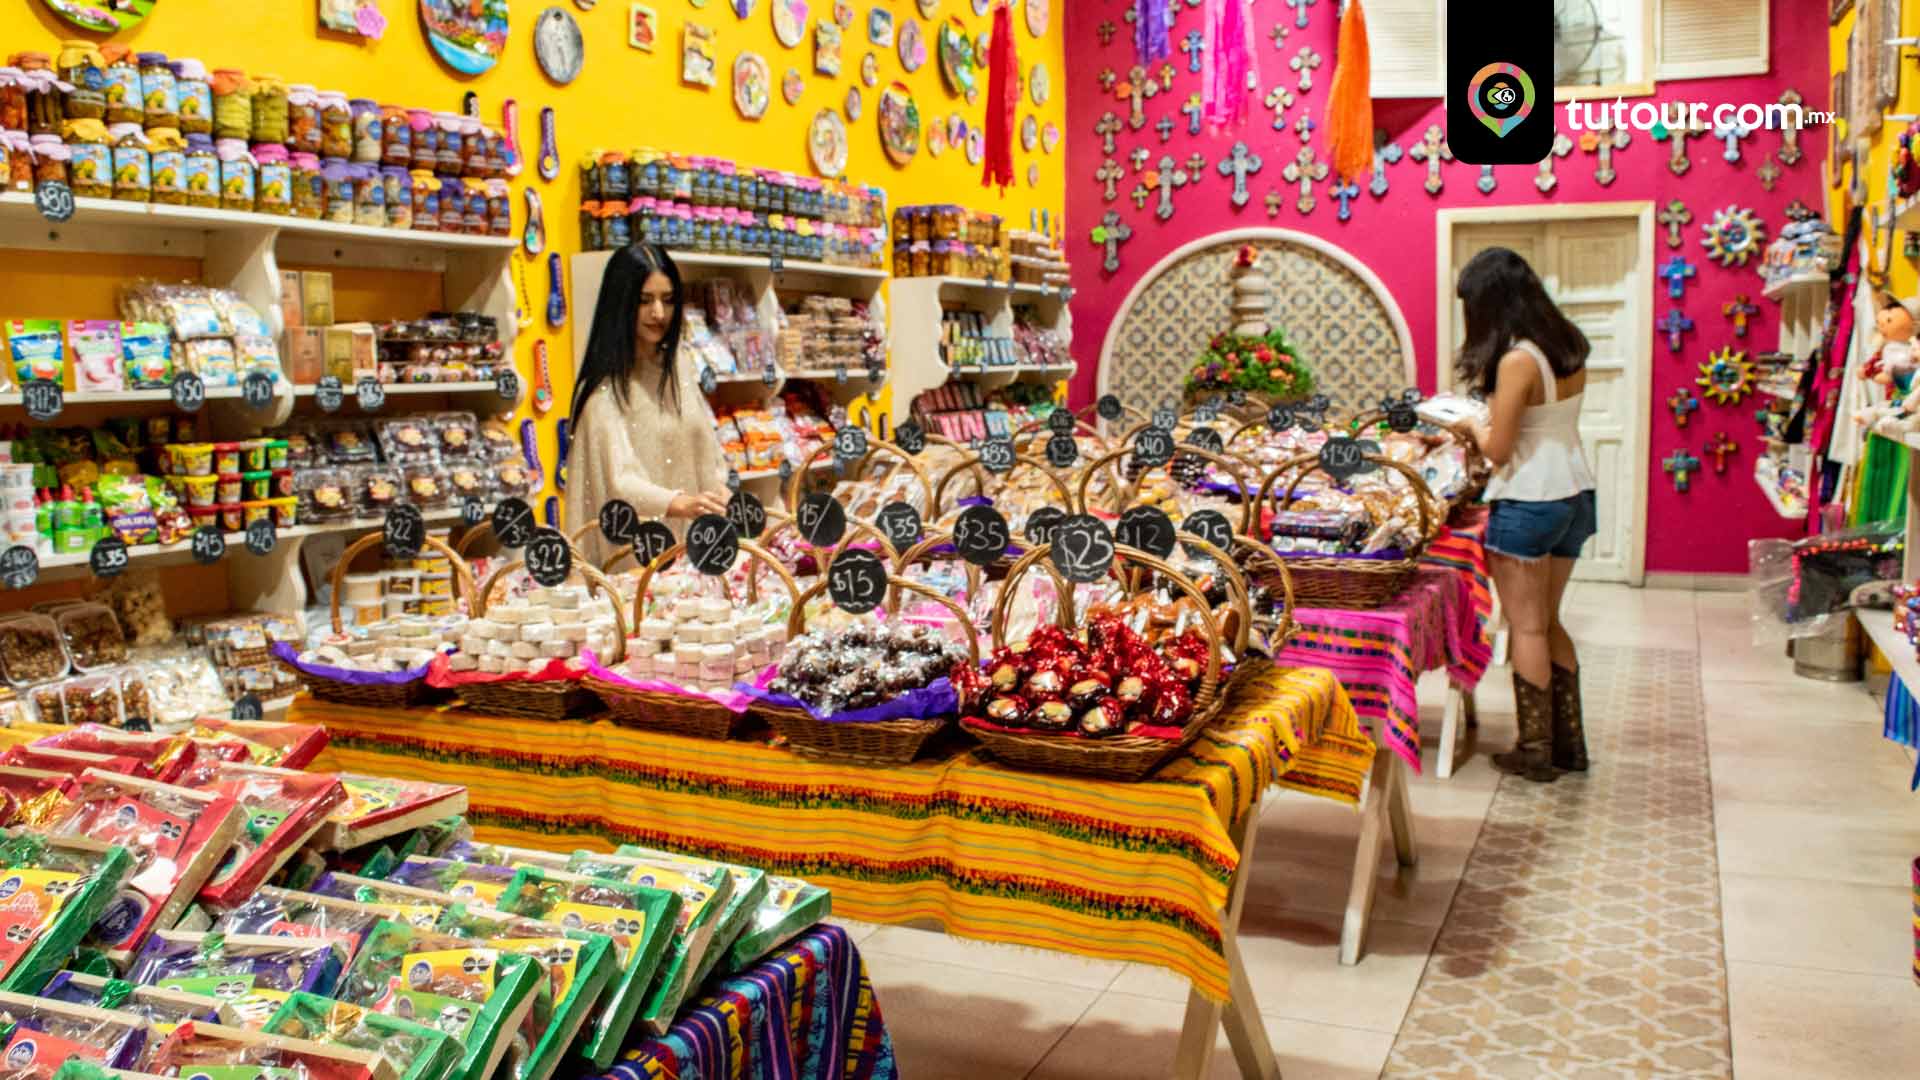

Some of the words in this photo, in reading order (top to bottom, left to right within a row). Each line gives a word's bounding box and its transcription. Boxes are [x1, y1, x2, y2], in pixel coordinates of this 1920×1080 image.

[385, 517, 412, 542] $22
[956, 517, 1005, 550] $35
[528, 543, 565, 572] $22
[1058, 529, 1114, 578] $25
[833, 568, 874, 597] $15
